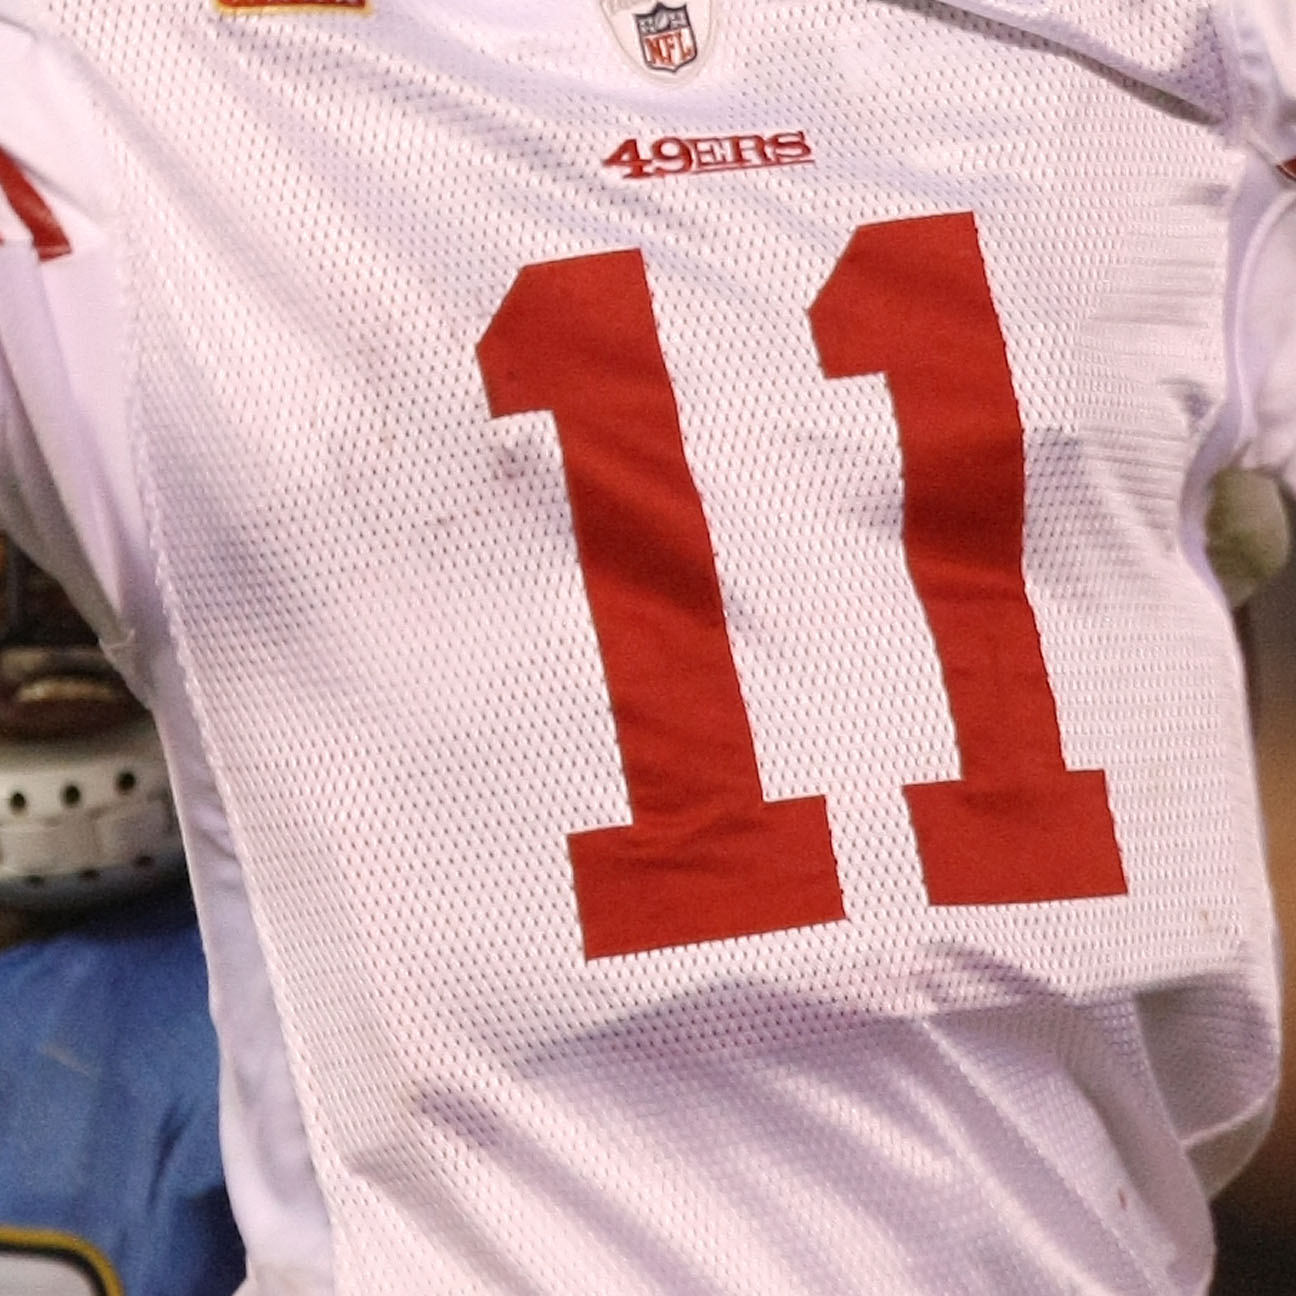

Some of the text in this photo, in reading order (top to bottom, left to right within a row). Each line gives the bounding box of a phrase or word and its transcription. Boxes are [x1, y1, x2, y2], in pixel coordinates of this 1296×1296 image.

[644, 28, 696, 66] NFL
[602, 130, 815, 179] 49ERS
[475, 211, 1128, 962] 11
